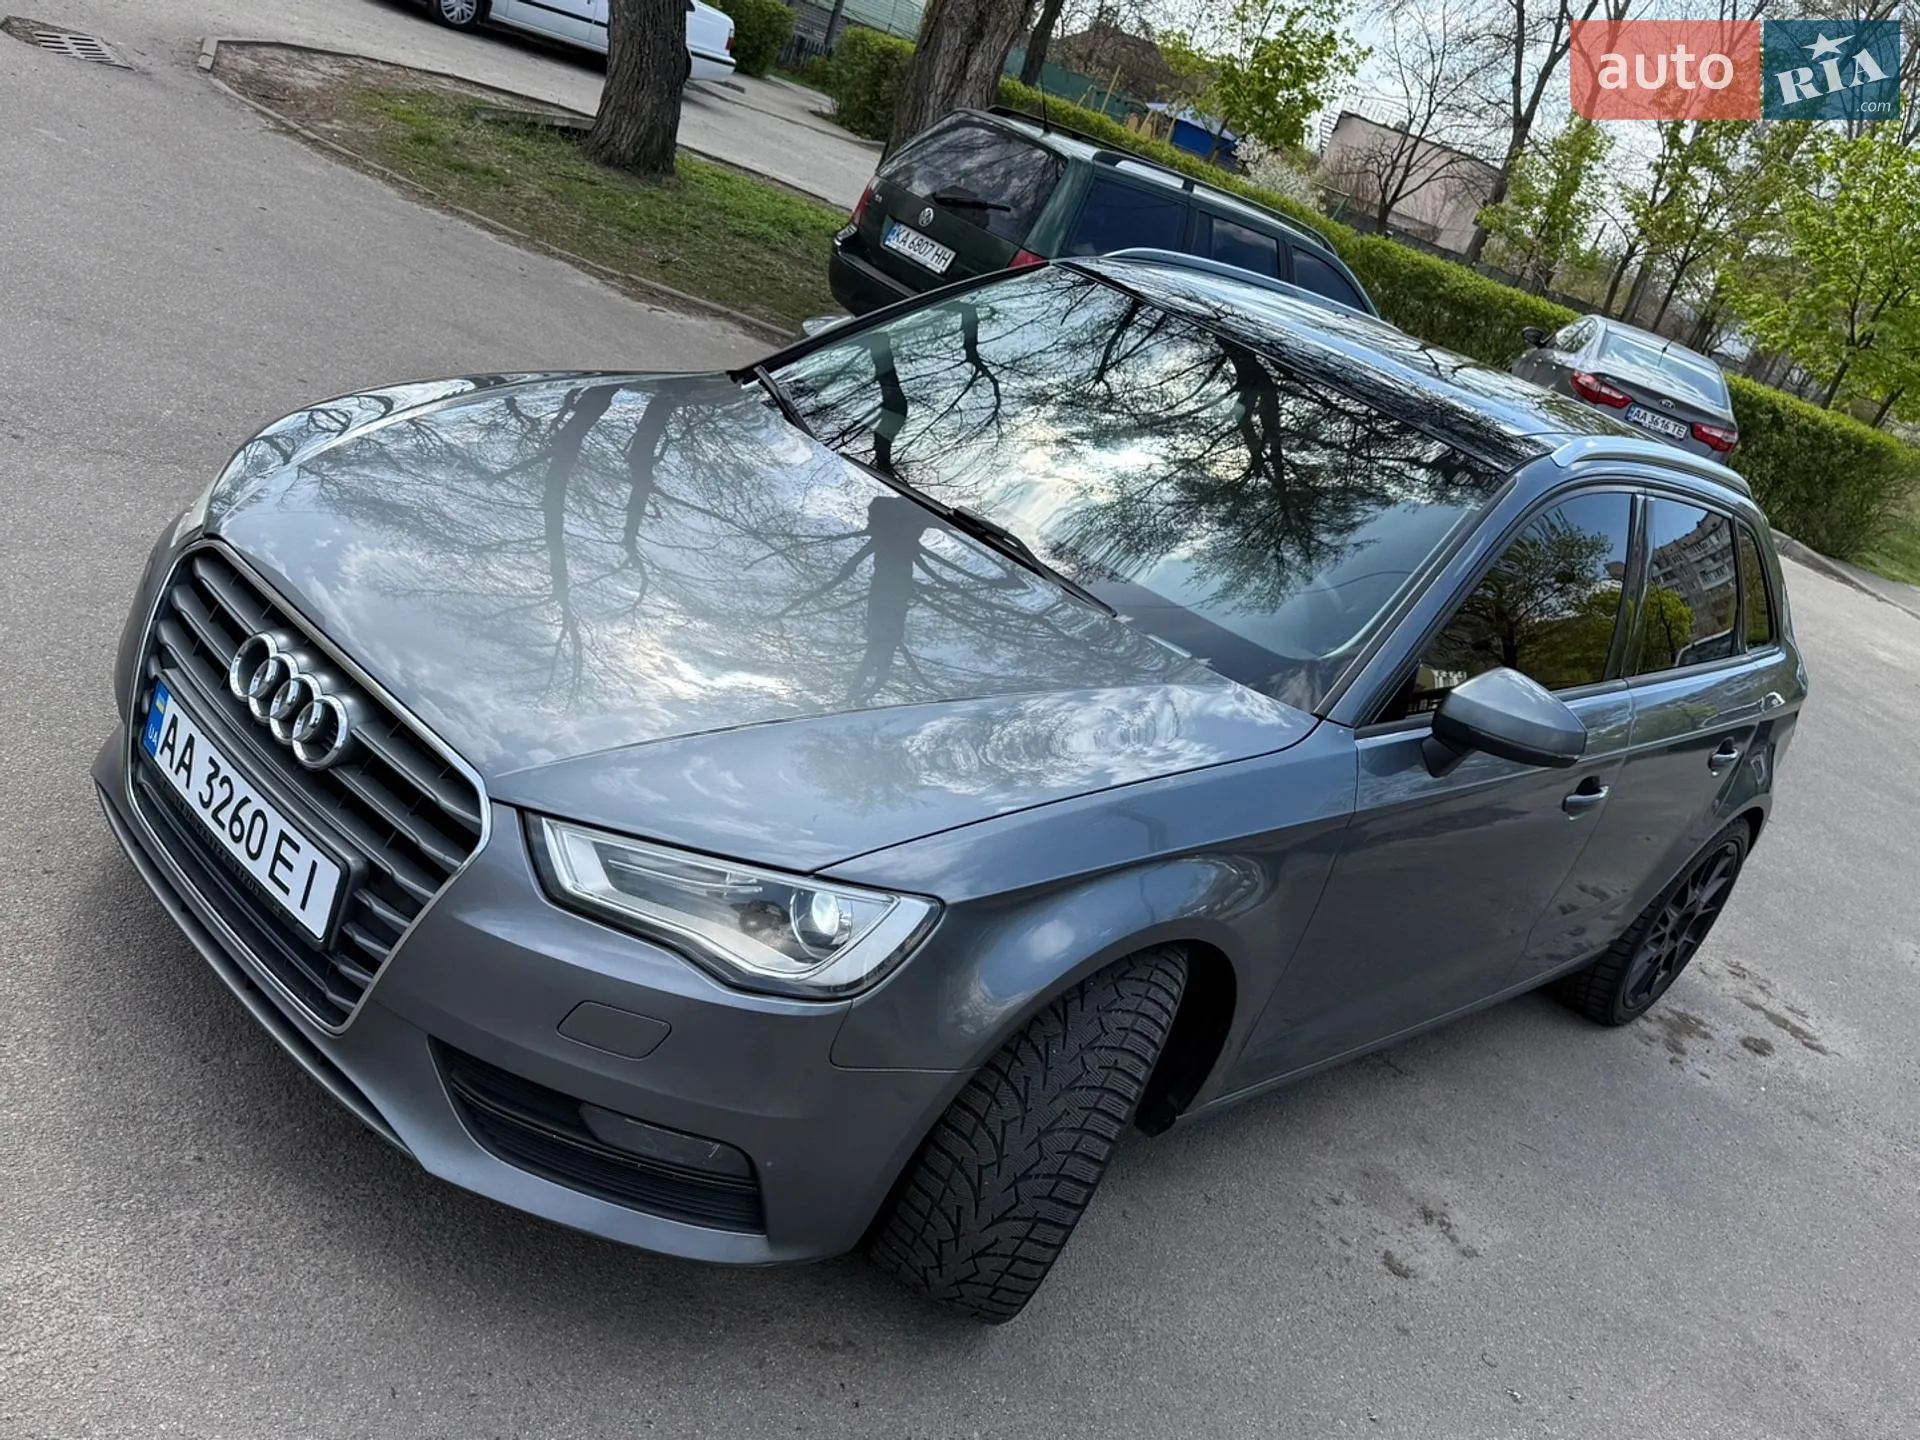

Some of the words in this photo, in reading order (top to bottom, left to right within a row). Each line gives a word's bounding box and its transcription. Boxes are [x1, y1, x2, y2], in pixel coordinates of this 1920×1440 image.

[894, 229, 911, 246] KA
[908, 235, 935, 256] 6807
[931, 247, 952, 268] HH
[1633, 409, 1647, 421] AA
[1673, 423, 1686, 437] TE
[159, 713, 196, 790] AA
[198, 756, 269, 862] 3260
[268, 829, 318, 911] EI
